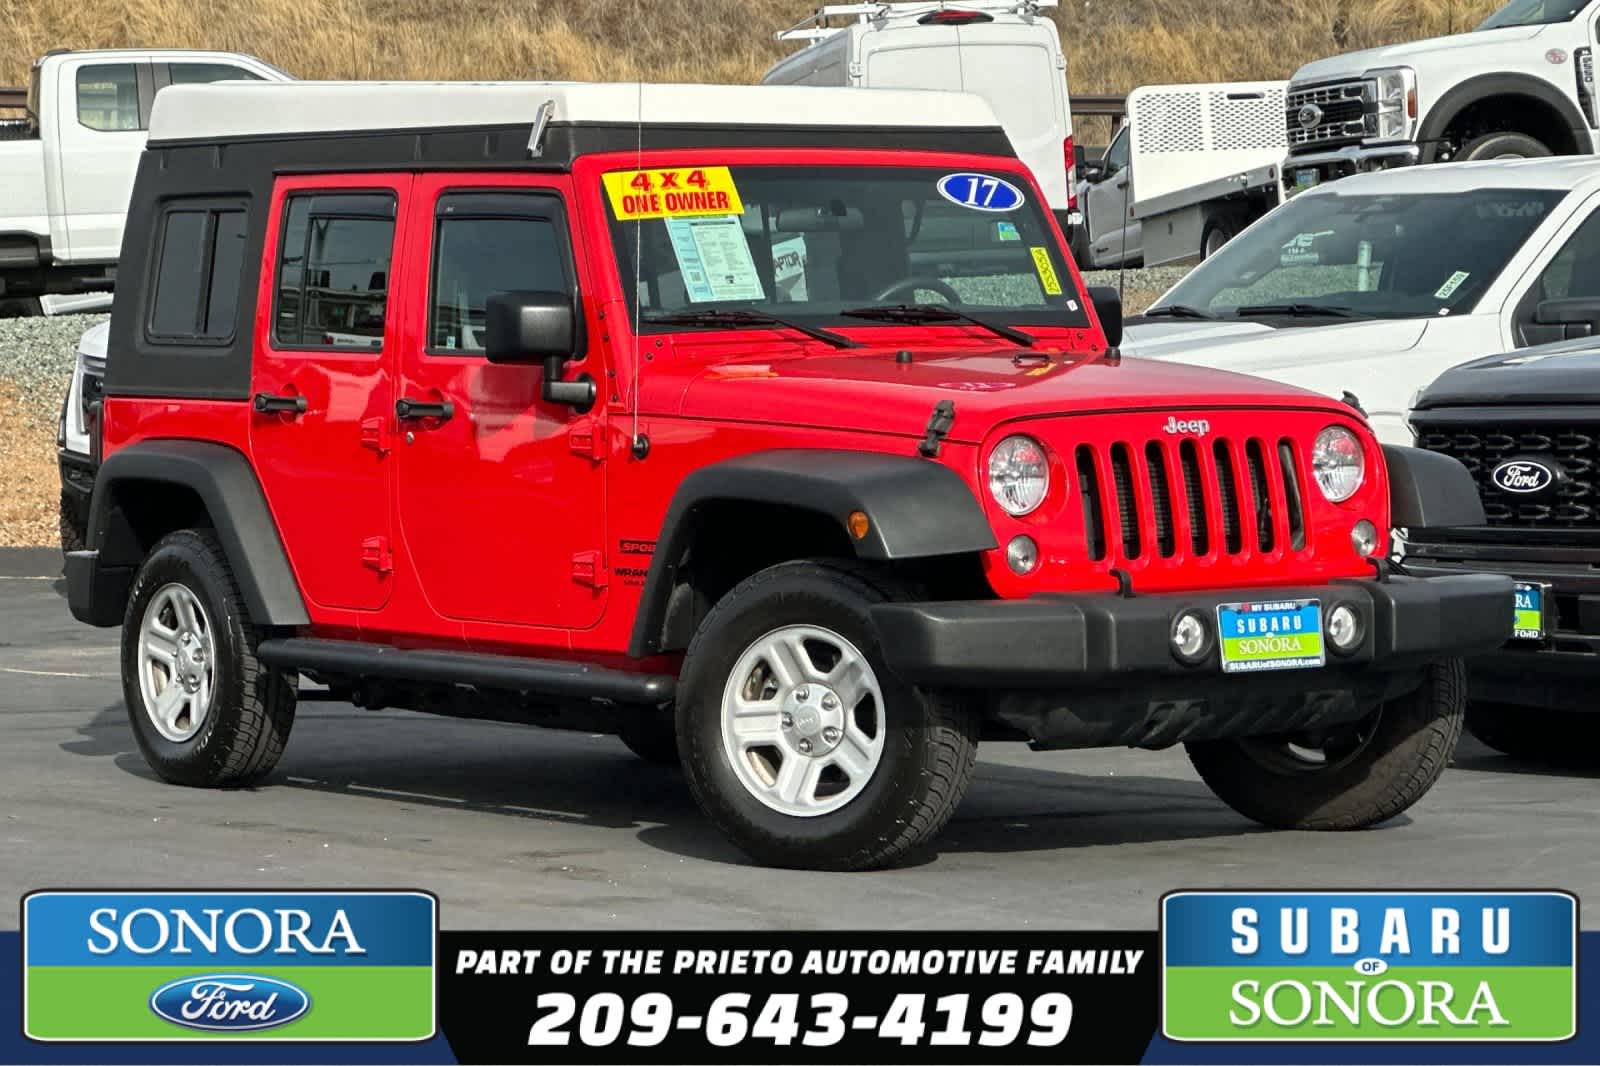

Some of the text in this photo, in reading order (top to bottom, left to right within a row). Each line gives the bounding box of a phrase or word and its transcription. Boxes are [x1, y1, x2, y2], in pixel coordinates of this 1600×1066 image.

[623, 191, 730, 214] ONE OWNER
[964, 177, 1000, 207] 17
[1163, 415, 1210, 438] Jeep
[1503, 465, 1541, 487] Ford
[1252, 602, 1296, 612] MY SUBARU
[1236, 615, 1302, 634] SUBARU
[1239, 637, 1303, 655] SONORA
